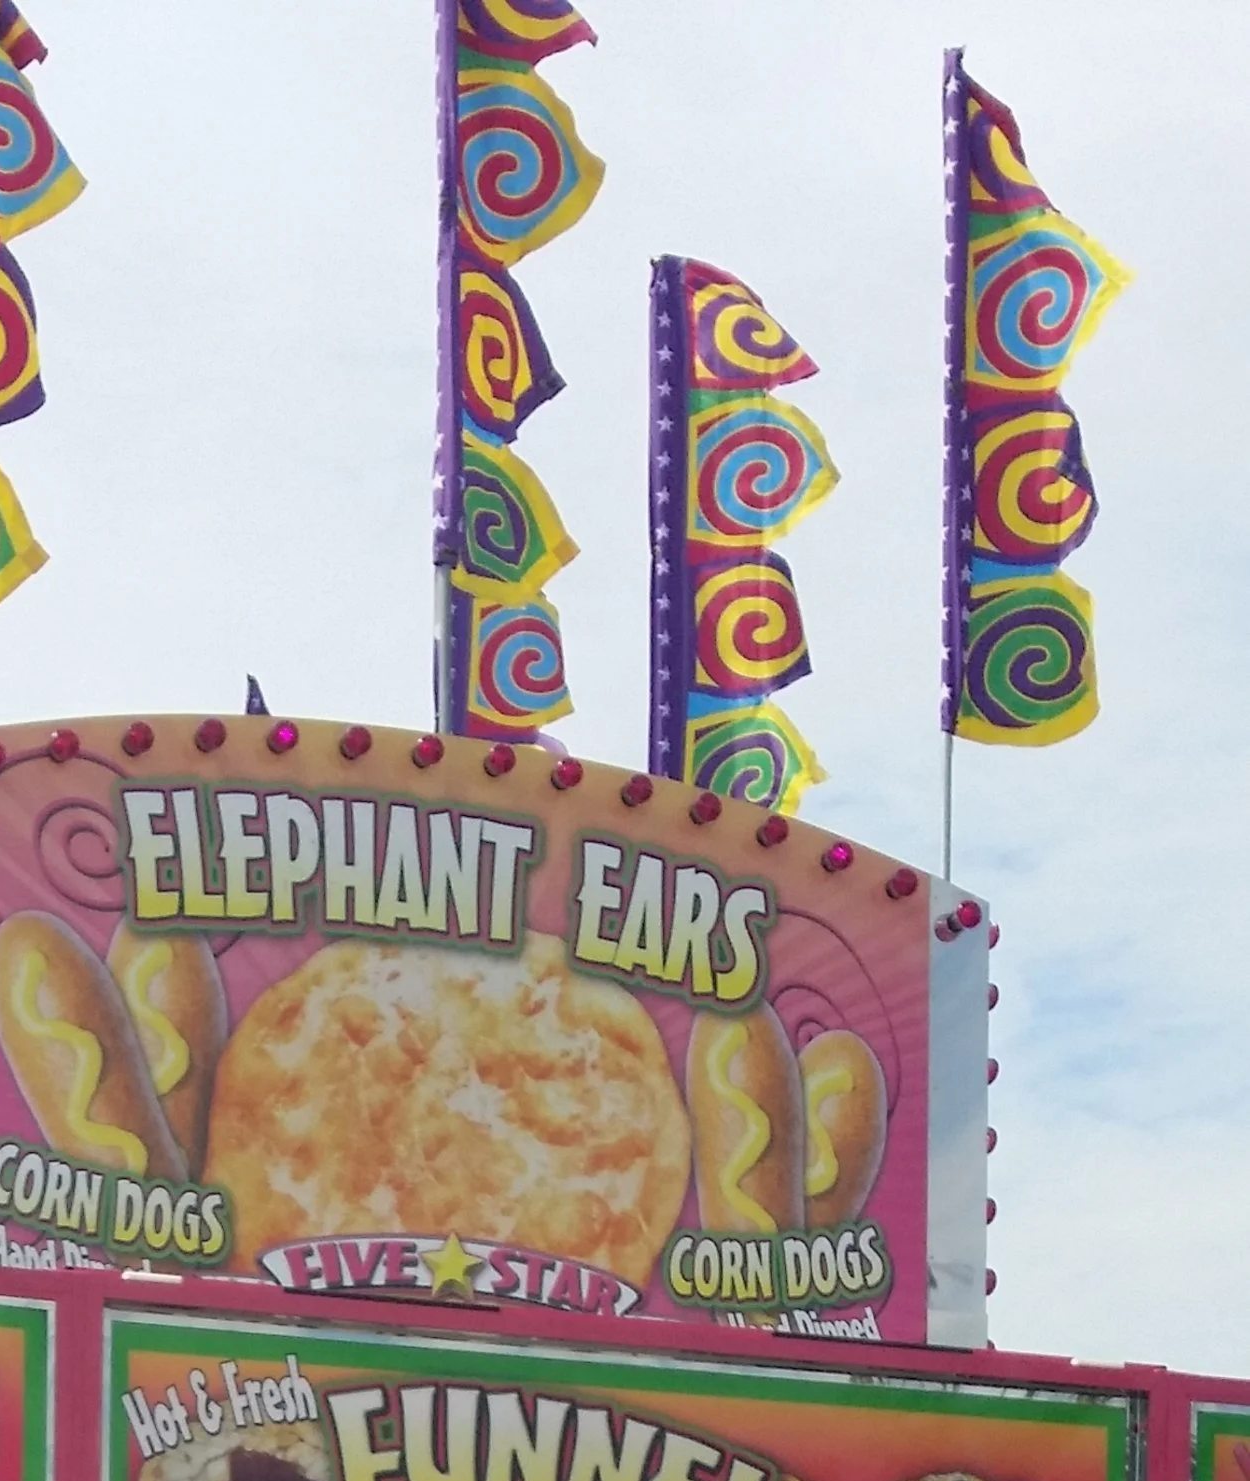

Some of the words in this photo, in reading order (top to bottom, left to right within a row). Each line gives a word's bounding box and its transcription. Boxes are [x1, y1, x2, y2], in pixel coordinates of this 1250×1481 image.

[120, 789, 533, 943] ELEPHANT
[573, 839, 767, 1001] EARS
[113, 1176, 226, 1255] DOGS
[283, 1241, 418, 1288] FIVE
[487, 1247, 622, 1317] STAR
[669, 1236, 775, 1300] CORN
[783, 1226, 884, 1297] DOGS
[121, 1385, 193, 1459] Hot
[189, 1368, 223, 1435] &
[220, 1353, 319, 1428] Fresh
